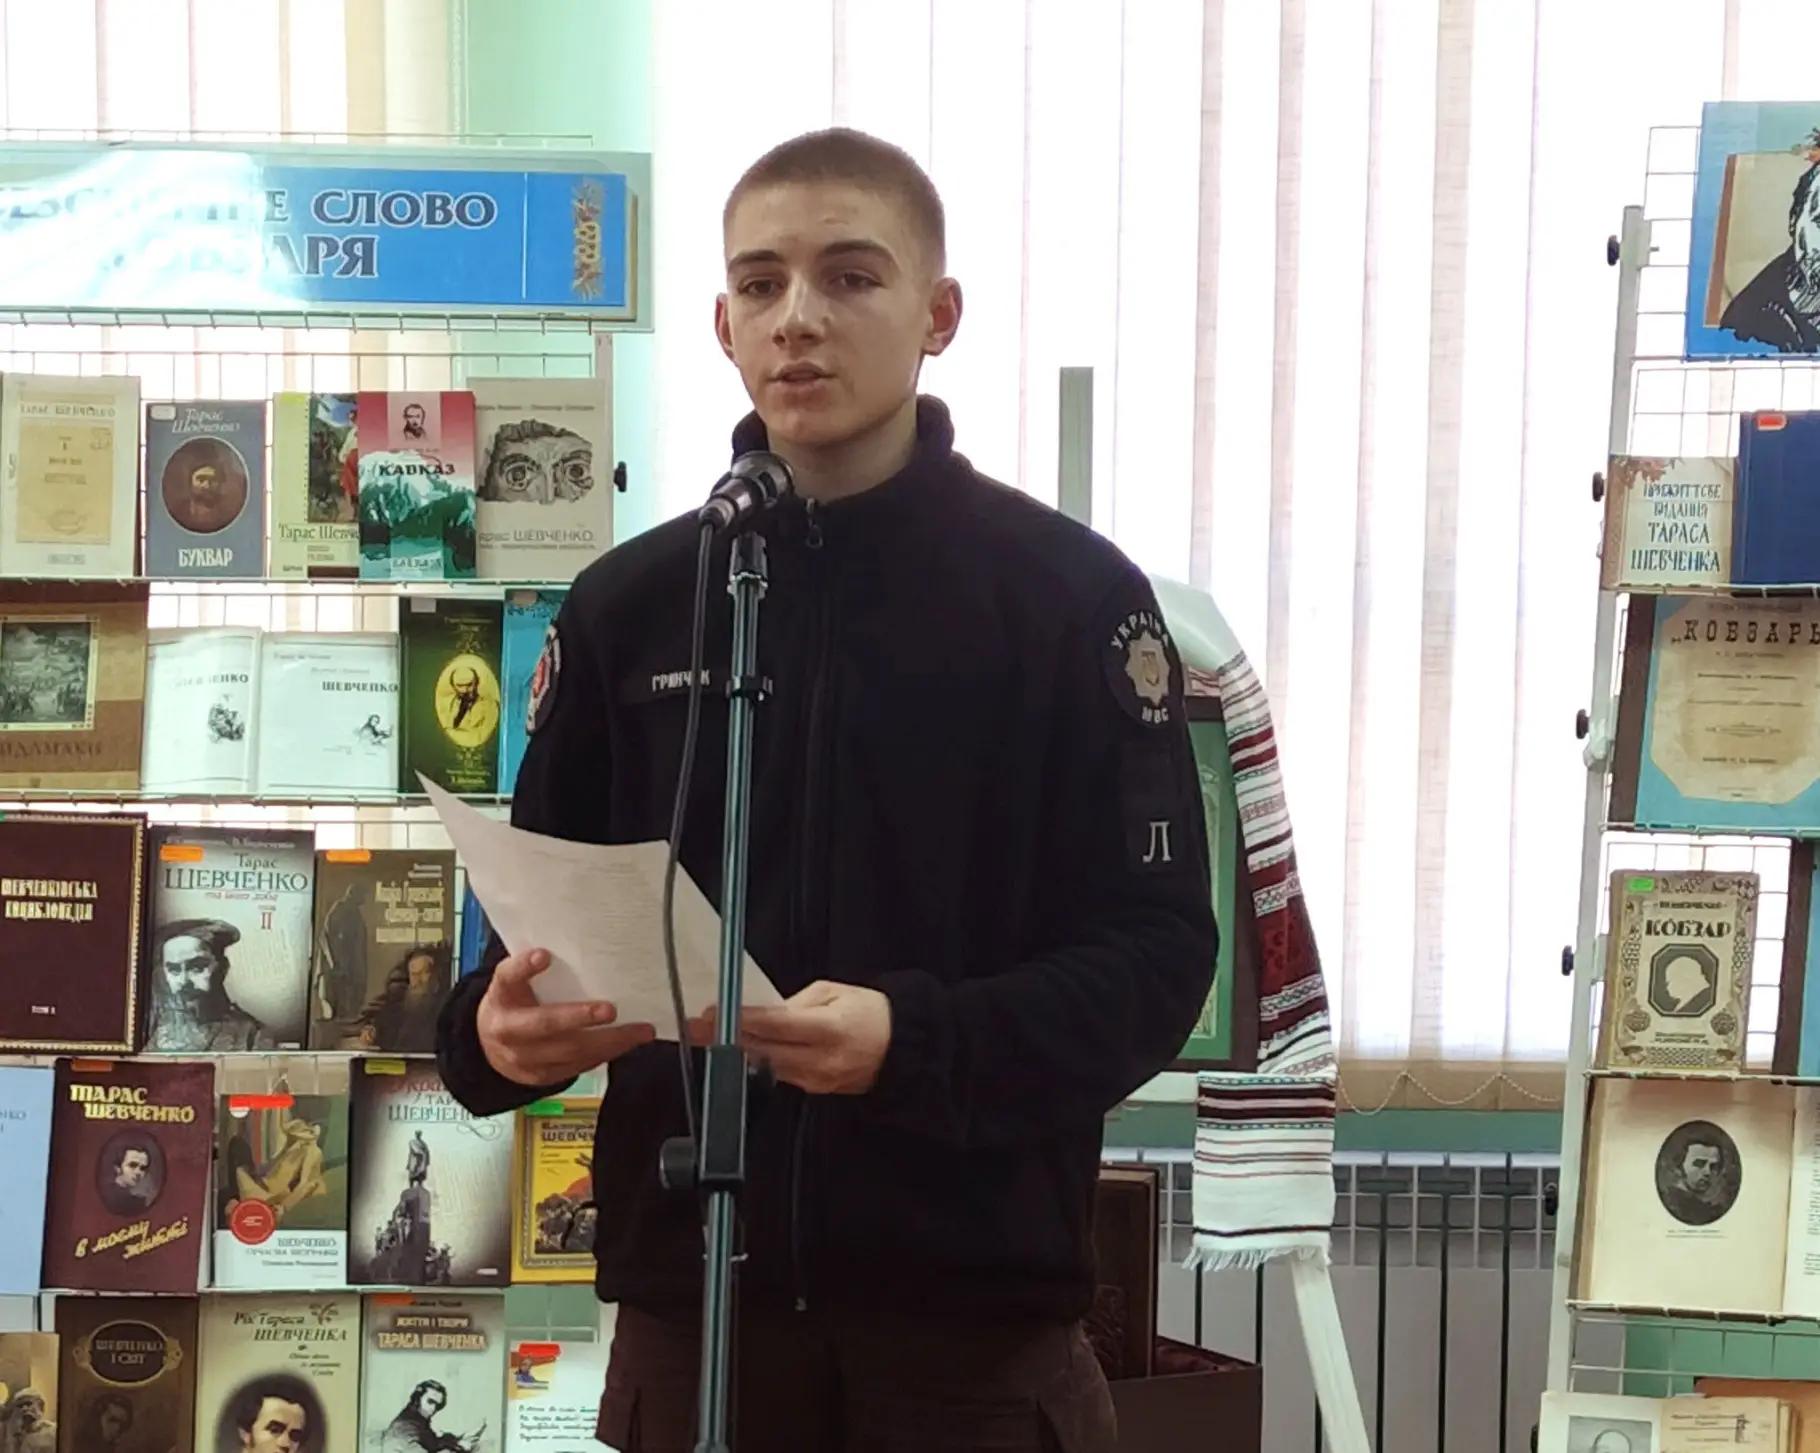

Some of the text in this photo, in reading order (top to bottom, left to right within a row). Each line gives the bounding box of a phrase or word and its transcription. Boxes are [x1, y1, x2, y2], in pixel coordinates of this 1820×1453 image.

[311, 189, 498, 229] СЛОВО
[379, 464, 456, 476] КАВКАЗ
[278, 522, 314, 542] Тарас
[513, 529, 594, 542] ШЕВЧЕНКО
[1648, 521, 1711, 544] ТАРАСА
[178, 549, 234, 567] БУКВАР
[1630, 549, 1721, 572] ШЕВЧЕНКА
[321, 680, 399, 693] ШЕВЧЕНКО
[651, 669, 711, 692] ГРИНЧК
[1142, 821, 1172, 863] Л
[234, 852, 279, 869] Тарас
[164, 868, 309, 892] ШЕВЧЕНКО
[1645, 917, 1732, 939] КОБЗАР
[69, 1084, 148, 1104] ТАРАС
[84, 1102, 195, 1123] ШЕВЧЕНКО
[253, 1327, 348, 1342] ШЕВЧЕНКА
[377, 1332, 486, 1350] ТАРАСА ШЕВЧЕНКА
